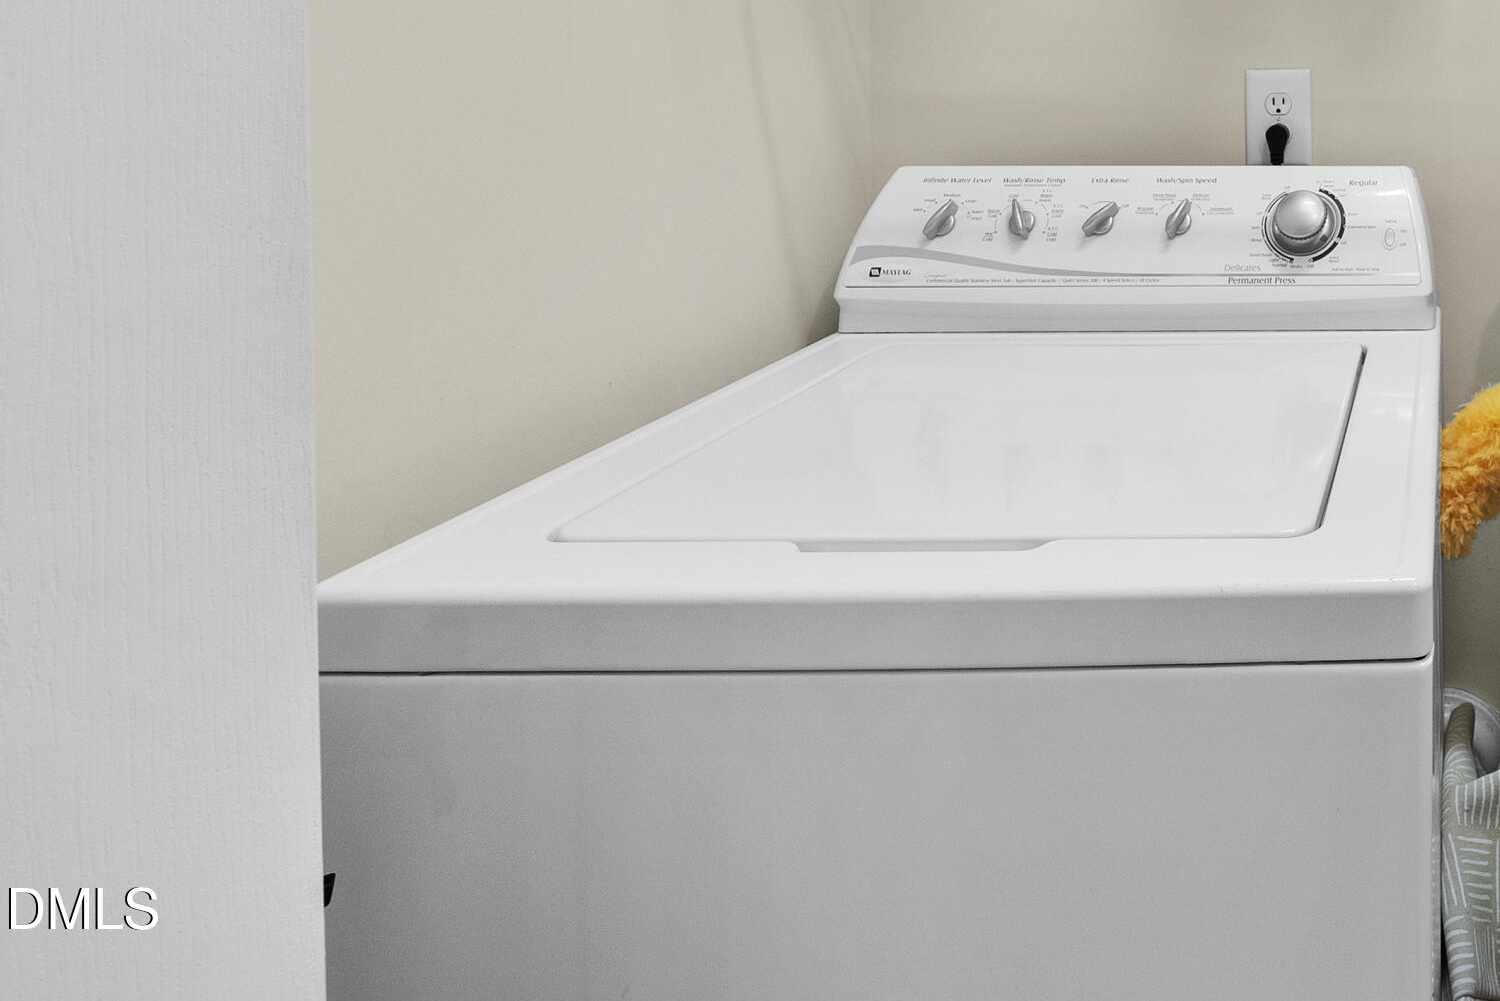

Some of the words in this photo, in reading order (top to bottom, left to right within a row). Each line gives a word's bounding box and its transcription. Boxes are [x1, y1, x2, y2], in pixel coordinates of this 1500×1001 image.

[923, 176, 949, 184] Infinite
[950, 176, 971, 184] Water
[972, 176, 992, 184] Level
[1003, 176, 1045, 185] Wash/Rinse
[1046, 176, 1066, 185] Temp
[1091, 176, 1109, 184] Extra
[1110, 176, 1130, 184] Rinse
[1156, 176, 1194, 185] Wash/Spin
[1195, 176, 1218, 185] Speed
[1349, 178, 1379, 187] Regular
[1224, 263, 1262, 272] Delicates
[1227, 276, 1272, 285] Permanent
[1274, 276, 1297, 285] Press
